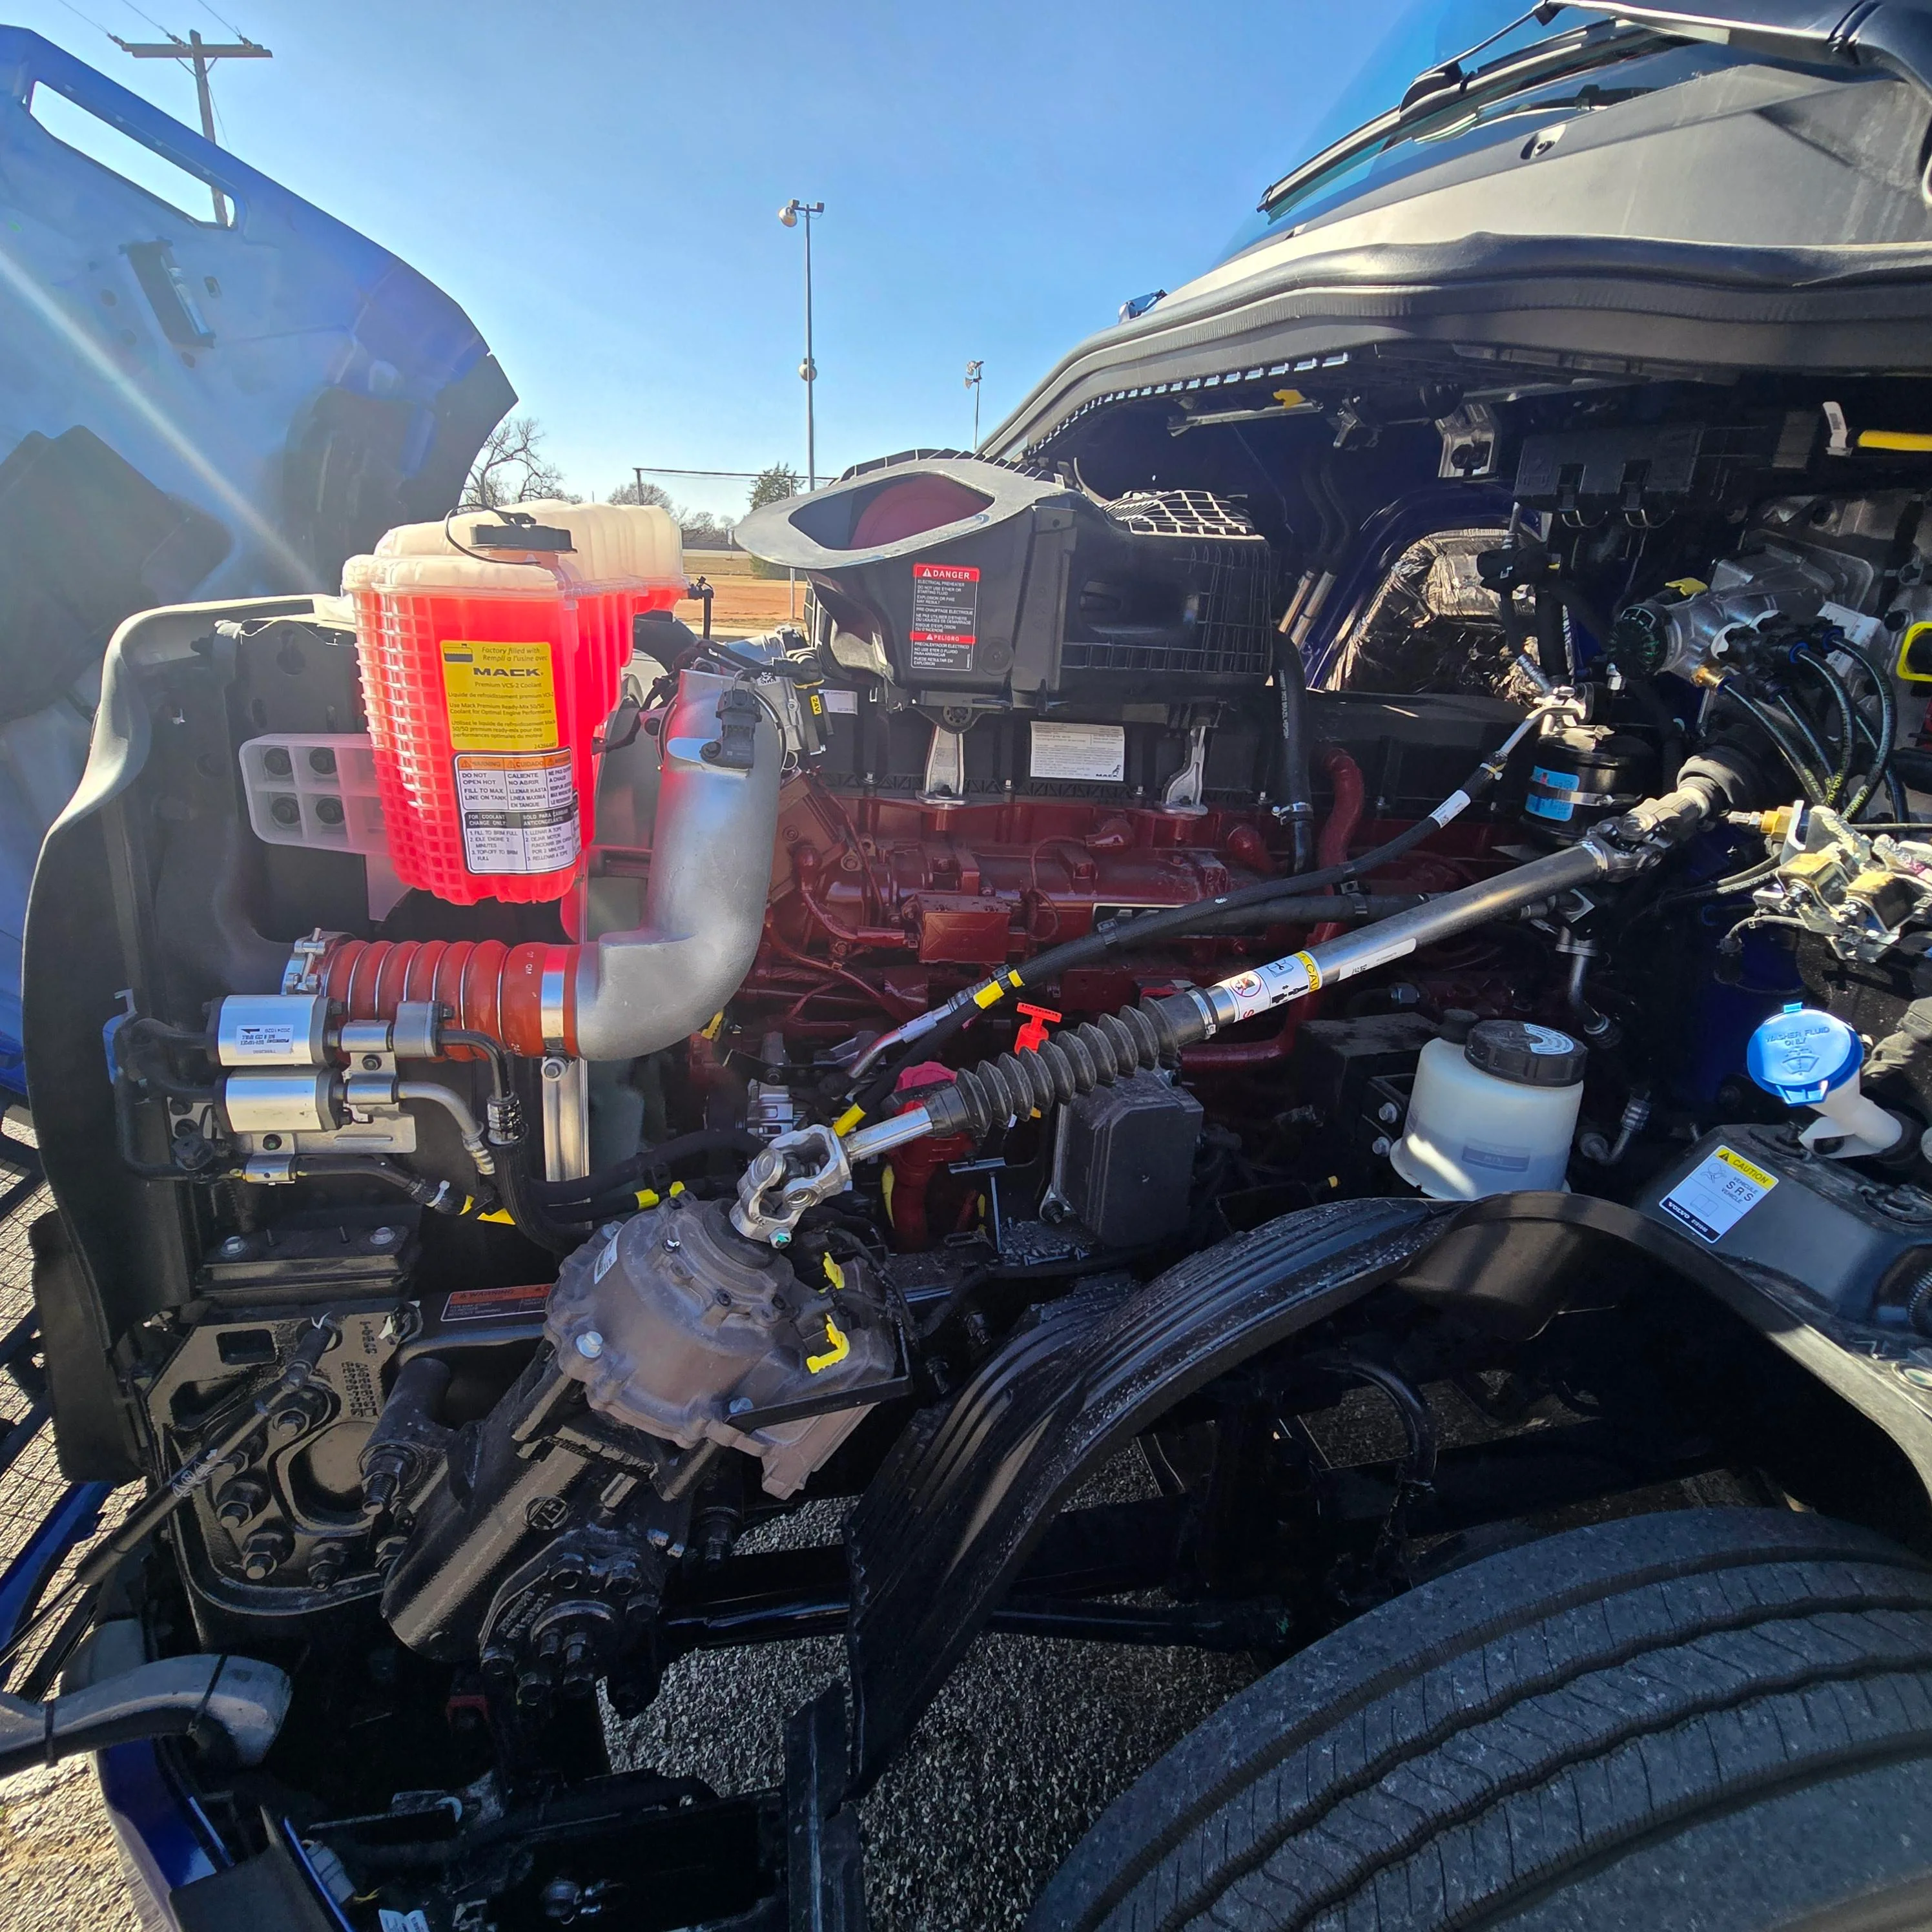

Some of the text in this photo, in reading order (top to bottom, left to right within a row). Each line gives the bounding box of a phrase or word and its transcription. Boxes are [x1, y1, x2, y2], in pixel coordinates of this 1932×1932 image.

[933, 570, 969, 579] DANGER
[473, 668, 540, 677] MACK
[1765, 1032, 1802, 1042] WASHER
[1785, 1038, 1807, 1046] ONLY
[1732, 1159, 1769, 1184] CAUTION
[1733, 1177, 1758, 1194] VEHICULE
[1721, 1187, 1743, 1204] VEHICLE
[1669, 1201, 1690, 1219] VOLVO
[469, 1289, 515, 1297] WARNING
